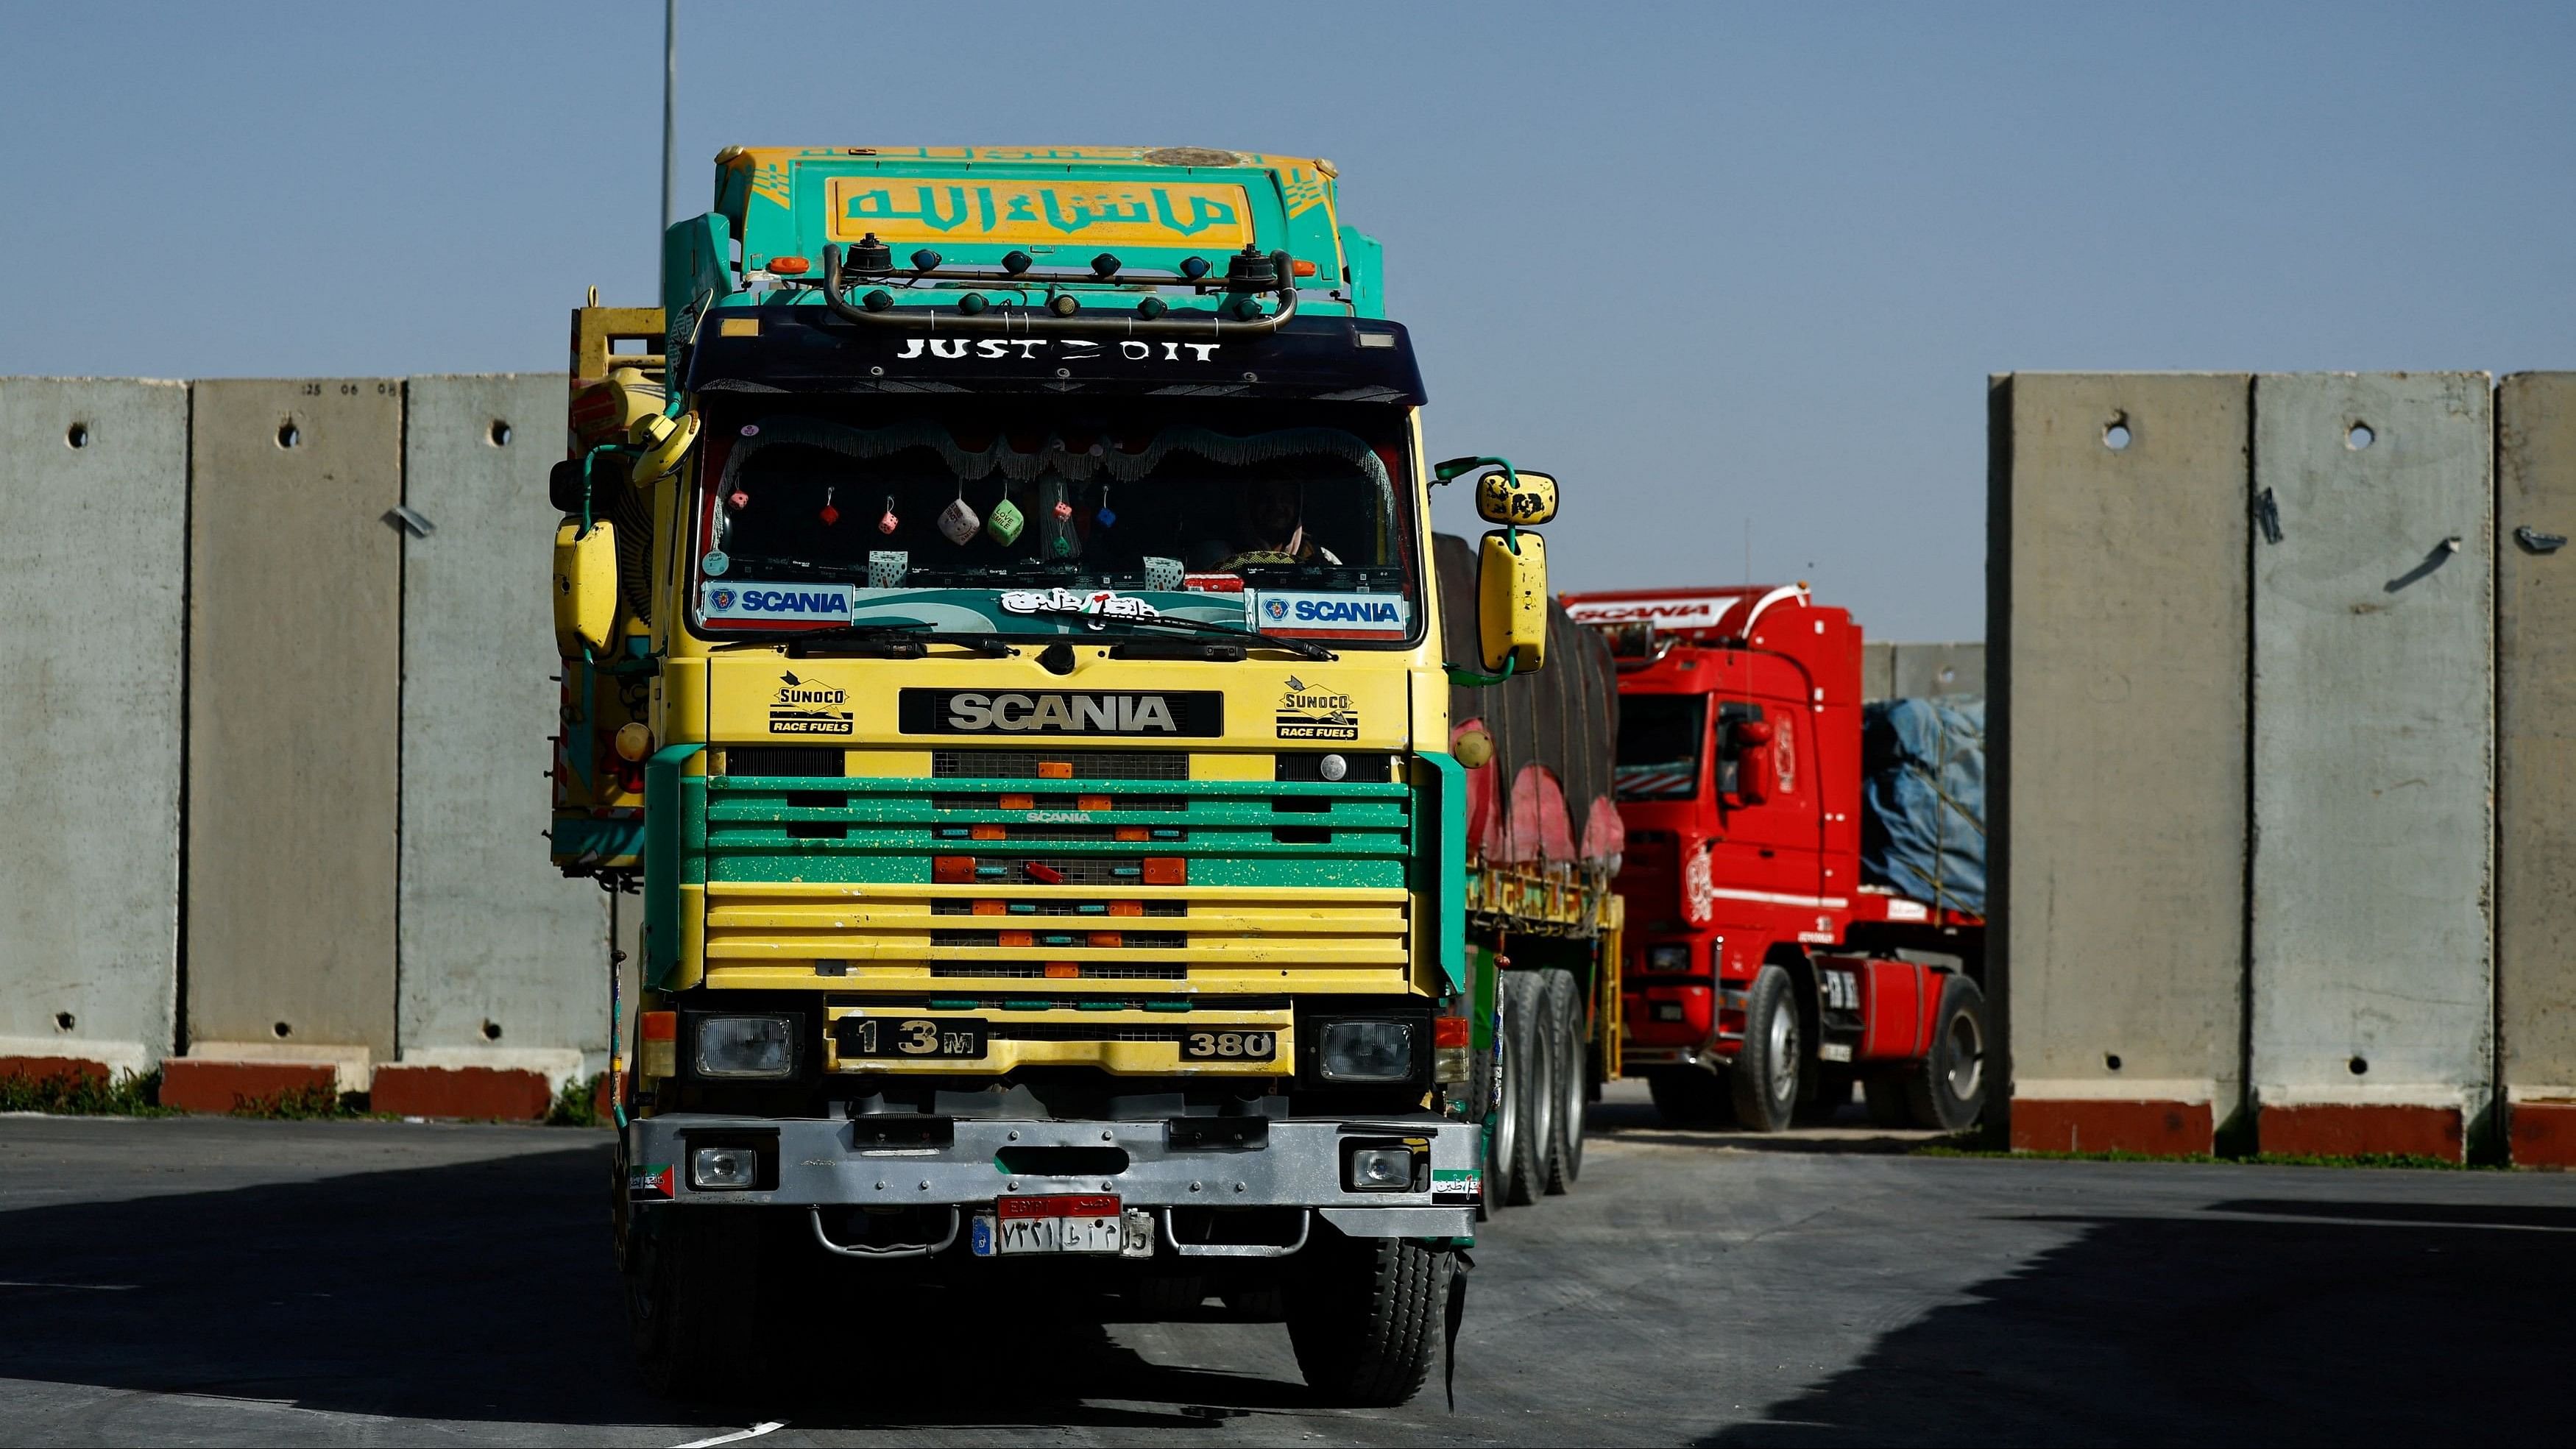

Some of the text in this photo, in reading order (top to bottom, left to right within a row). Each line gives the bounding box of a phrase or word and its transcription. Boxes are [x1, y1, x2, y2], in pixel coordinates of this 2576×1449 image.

[845, 185, 1238, 237] ما شاء الله
[897, 339, 1047, 358] JUST
[1161, 342, 1220, 361] IT
[991, 514, 1011, 530] SMILE
[996, 509, 1014, 527] LOVE
[742, 590, 849, 613] SCANIA
[1295, 600, 1400, 622] SCANIA
[1574, 604, 1710, 621] SCANIA
[780, 689, 844, 704] SUNOCO
[1286, 694, 1348, 709] SUNOCO
[948, 693, 1177, 731] SCANIA
[774, 723, 849, 732] RACE FUELS
[1281, 728, 1355, 738] RACE FUELS
[1026, 812, 1093, 822] SCANIA
[1189, 1032, 1272, 1057] 380
[1010, 1200, 1052, 1213] EGYPT
[1074, 1198, 1111, 1211] مصر
